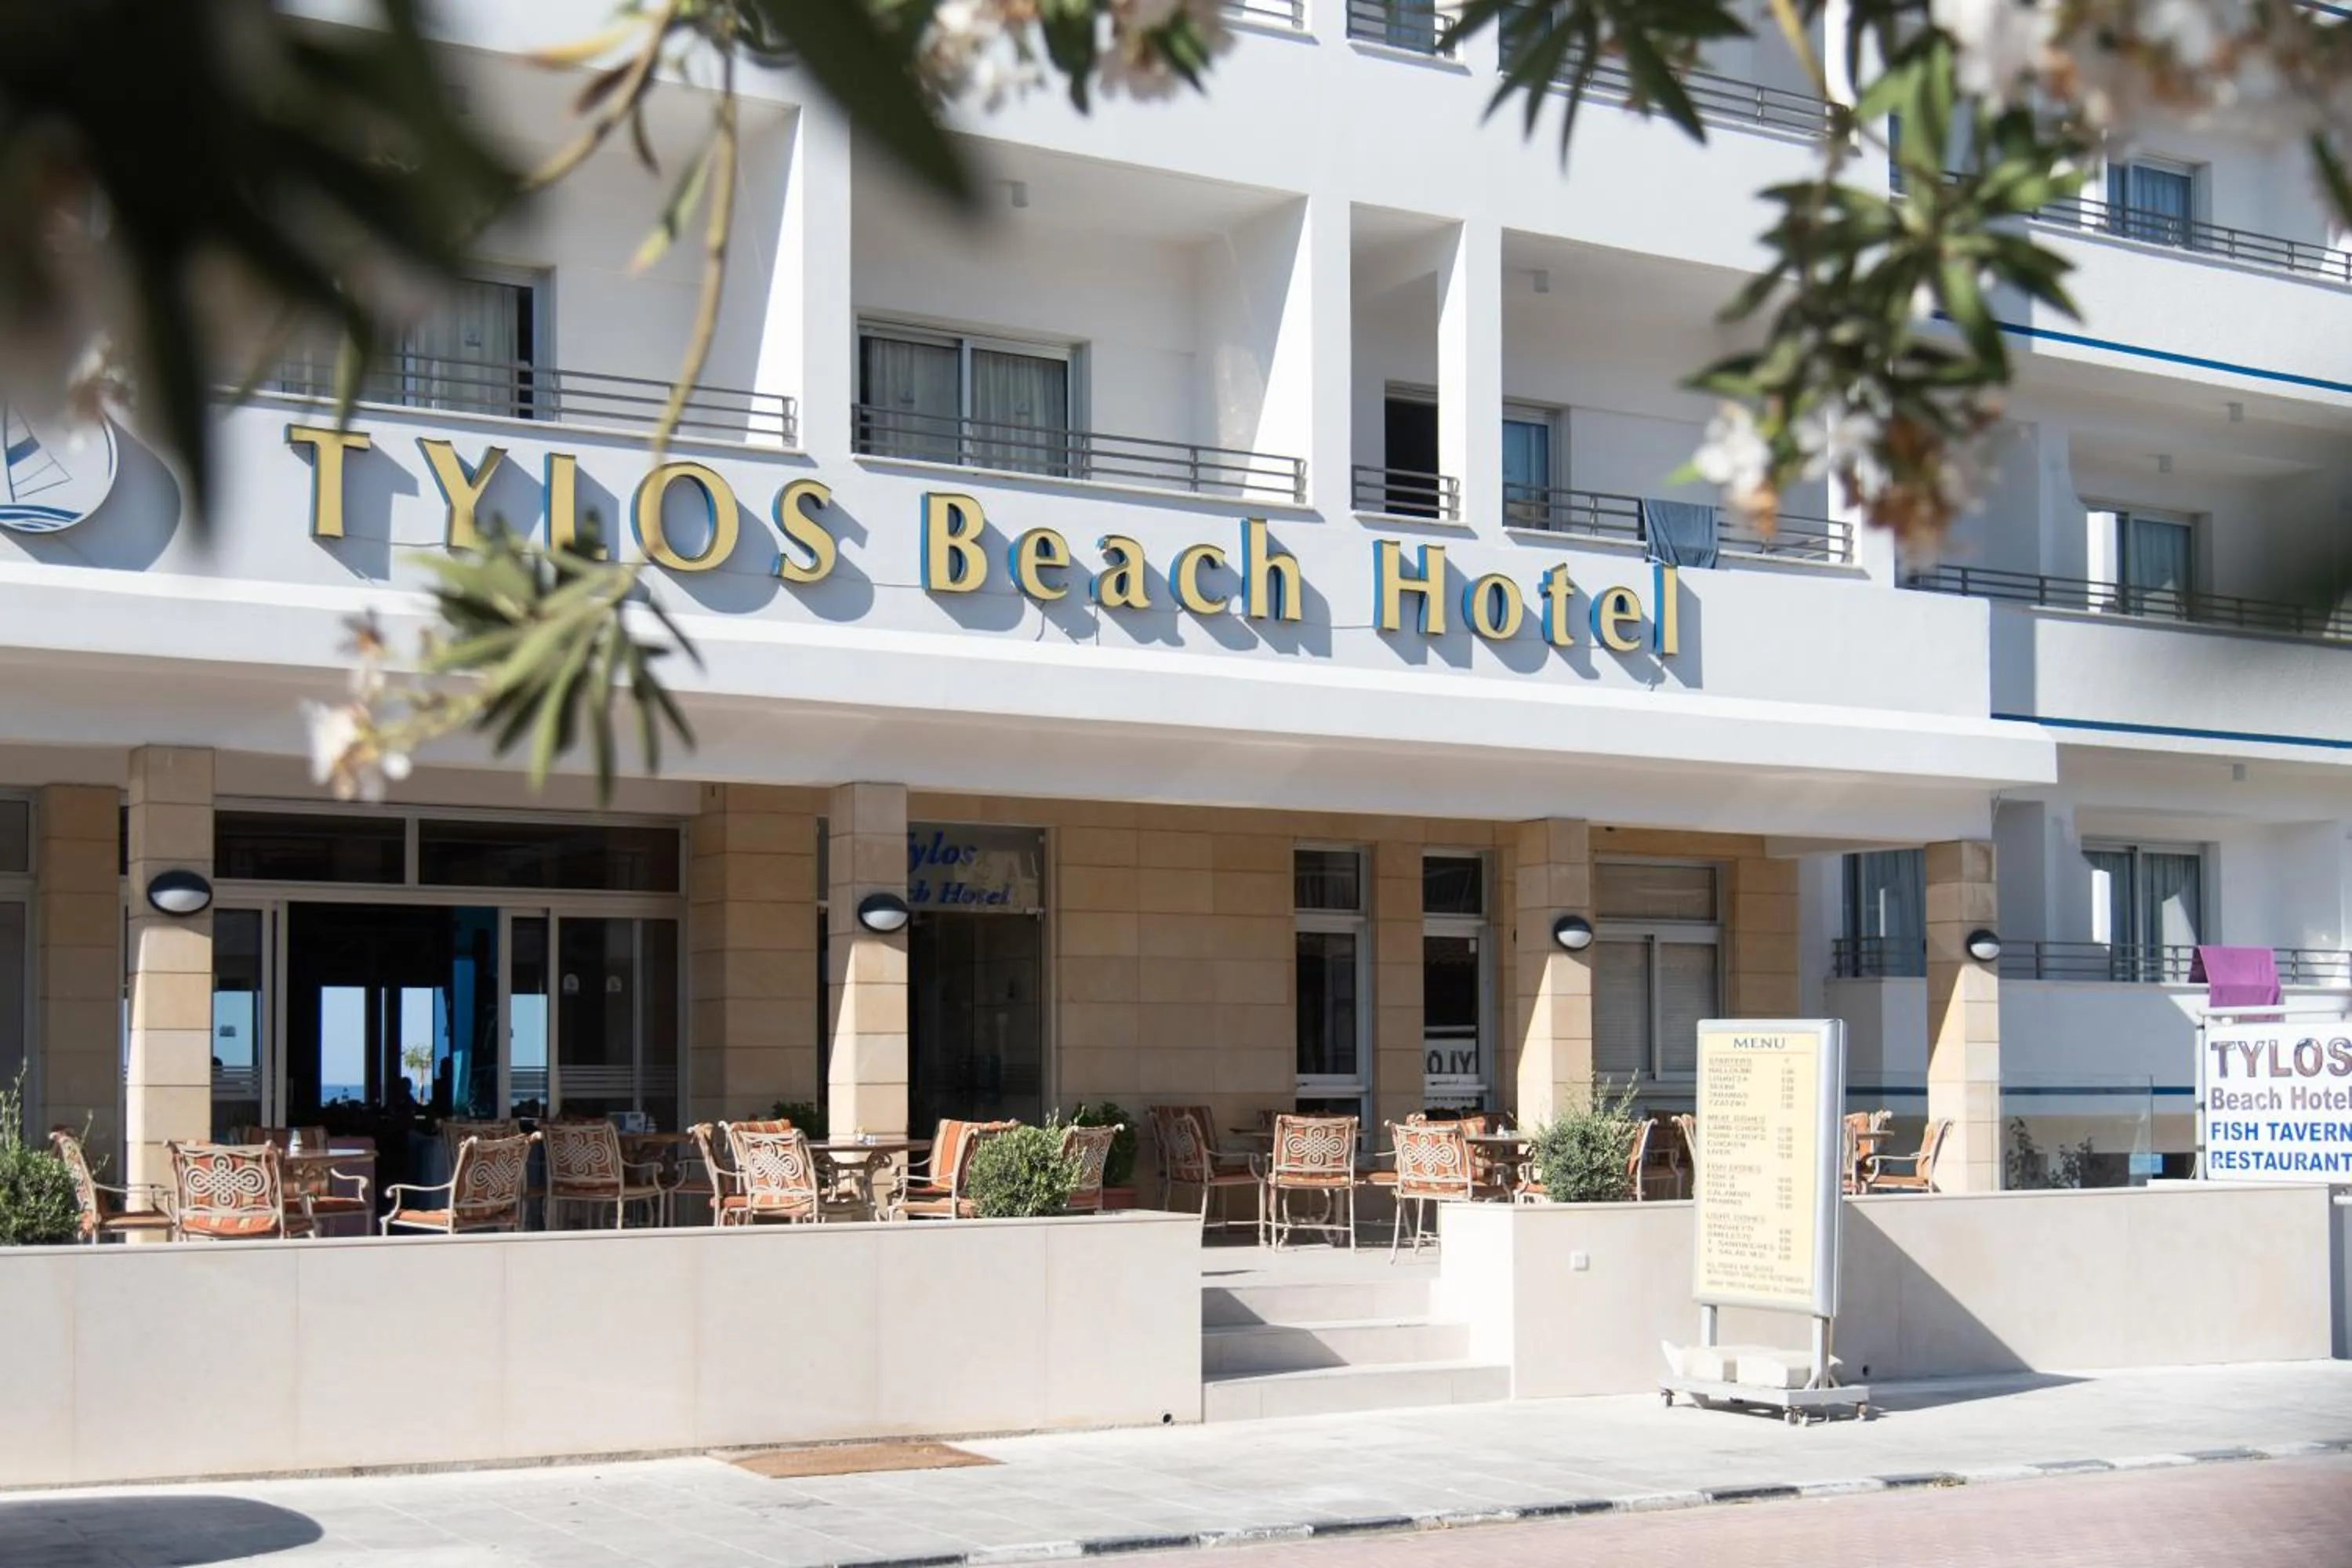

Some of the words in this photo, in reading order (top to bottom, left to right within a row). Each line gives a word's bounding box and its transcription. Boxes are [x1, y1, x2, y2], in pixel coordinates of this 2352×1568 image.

[285, 424, 837, 586] TYLOS
[921, 491, 1302, 622] Beach
[1373, 539, 1679, 656] Hotel
[907, 830, 978, 873] ylos
[1733, 1036, 1786, 1049] MENU
[2210, 1037, 2352, 1079] TYLOS
[2211, 1086, 2282, 1111] Beach
[2291, 1086, 2352, 1111] Hotel
[2211, 1122, 2259, 1141] FISH
[2267, 1122, 2352, 1142] TAVERN
[2211, 1151, 2352, 1171] RESTAURANT
